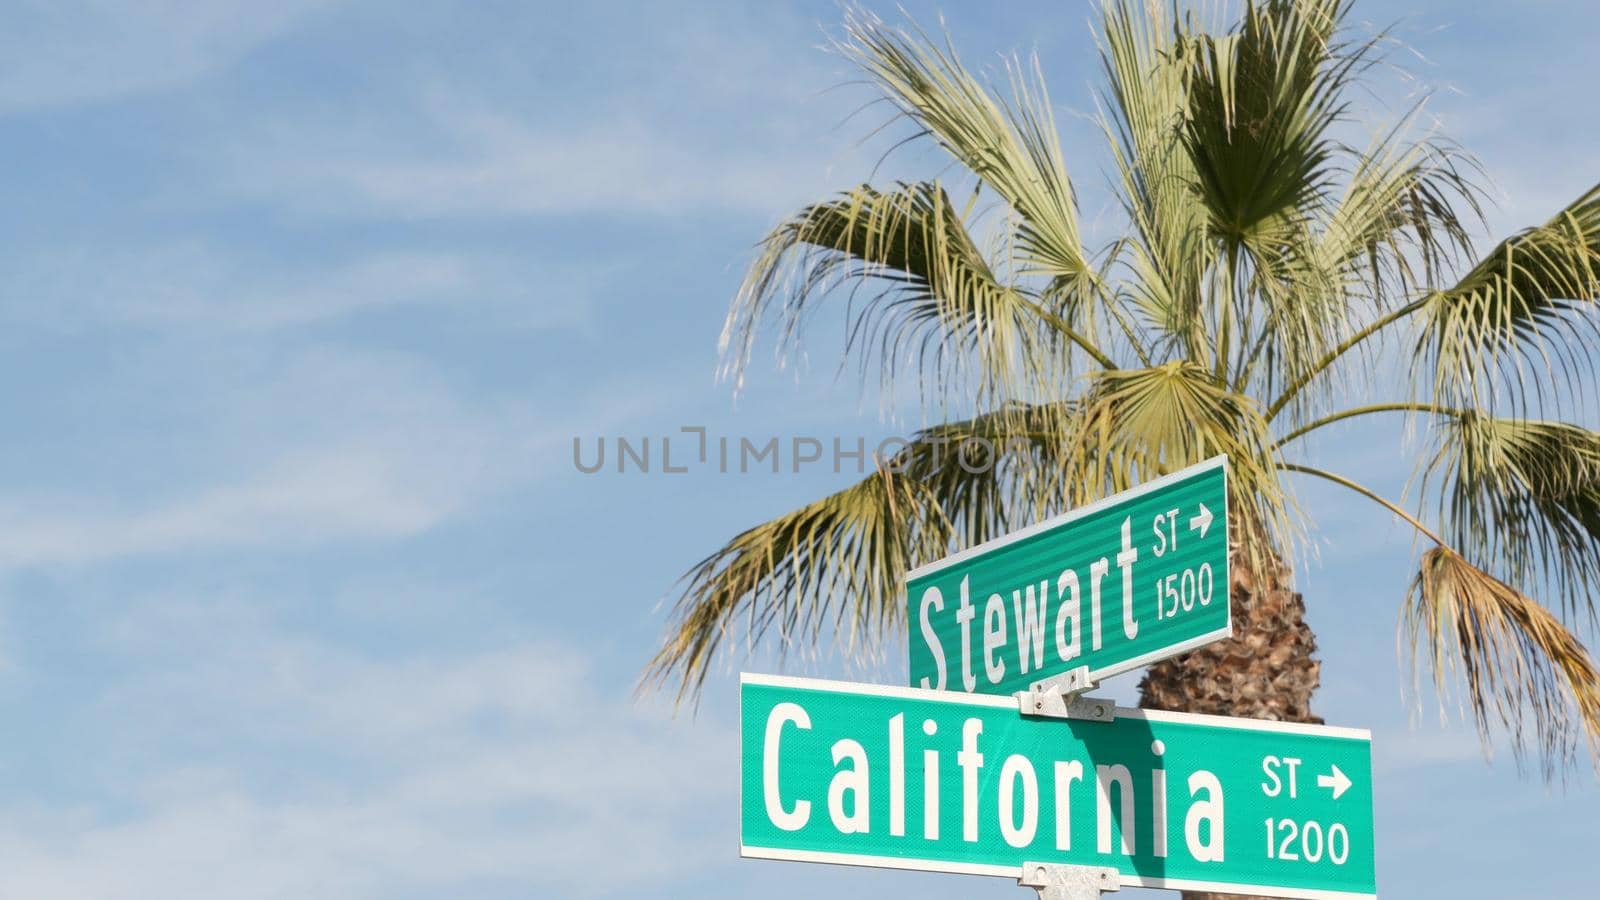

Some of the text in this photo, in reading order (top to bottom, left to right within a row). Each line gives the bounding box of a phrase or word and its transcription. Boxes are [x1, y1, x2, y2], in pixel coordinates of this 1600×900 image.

[919, 508, 1179, 693] Stewart ST
[1156, 562, 1213, 620] 1500
[763, 702, 1301, 862] California ST
[1265, 818, 1350, 865] 1200
